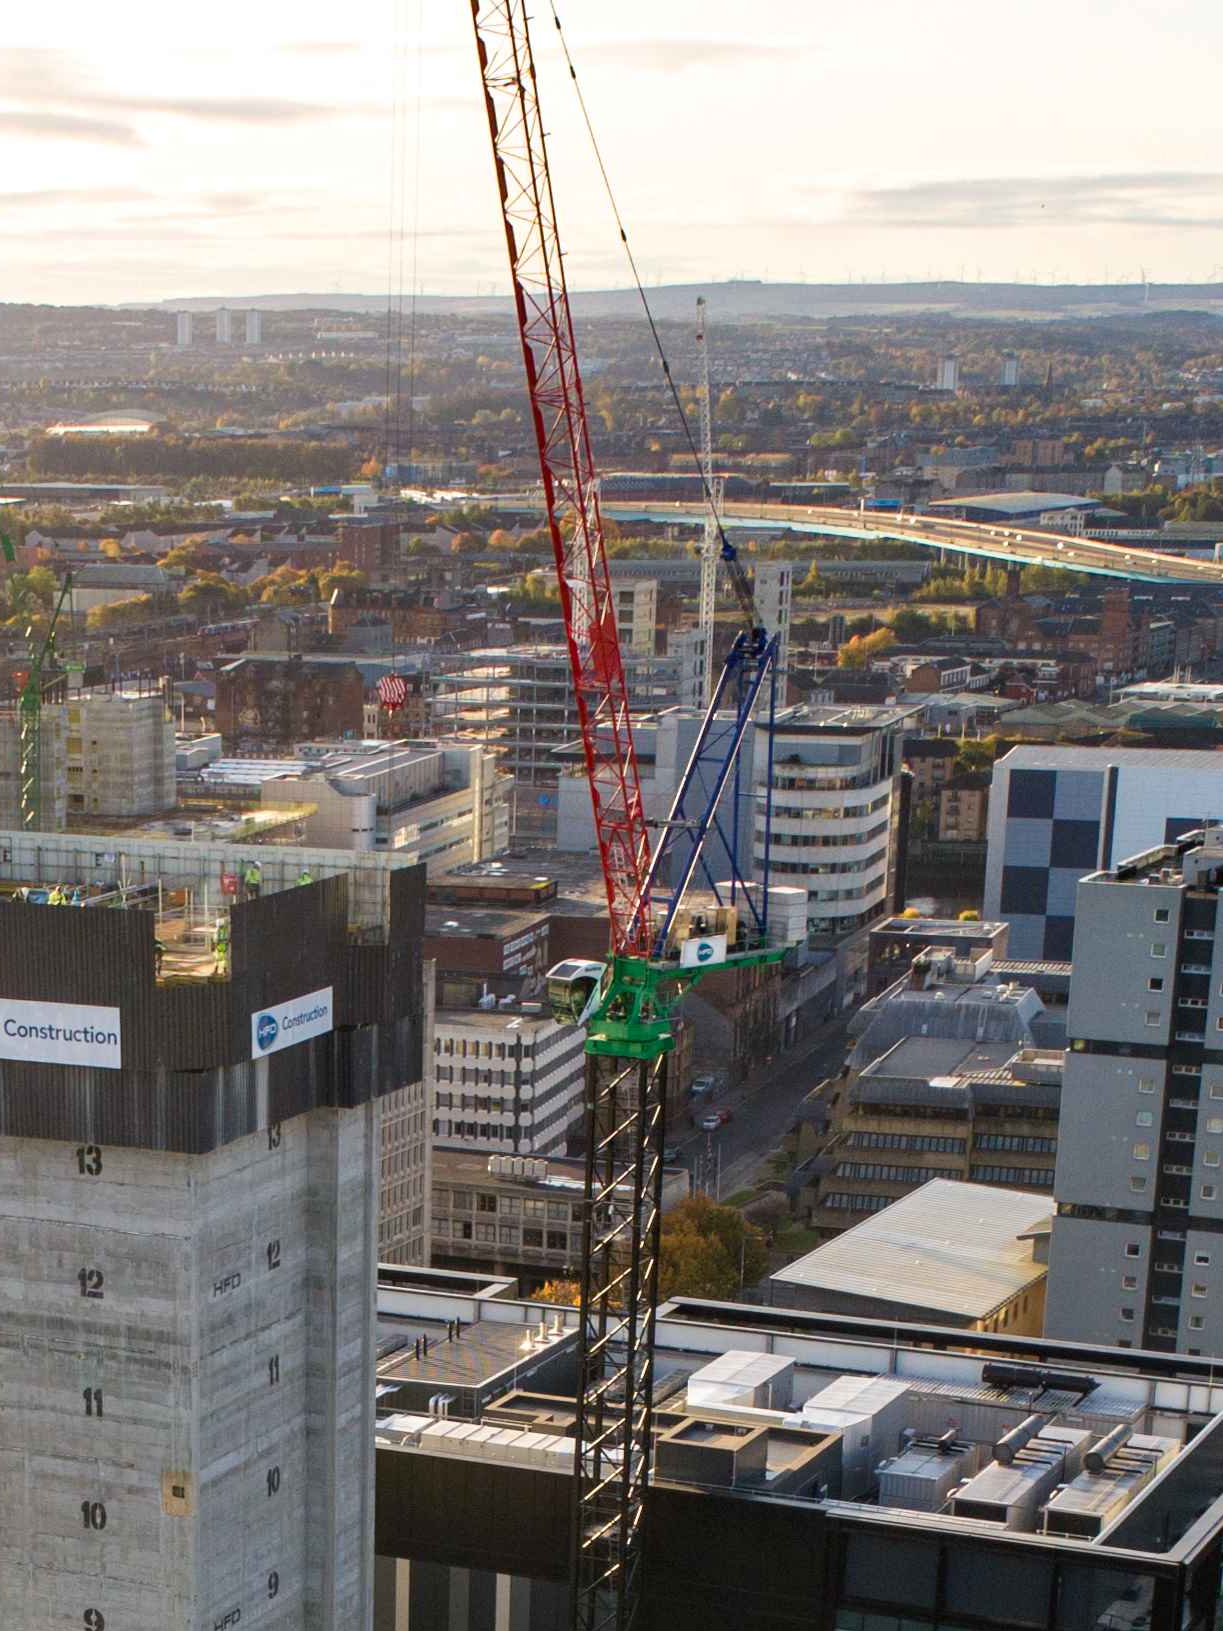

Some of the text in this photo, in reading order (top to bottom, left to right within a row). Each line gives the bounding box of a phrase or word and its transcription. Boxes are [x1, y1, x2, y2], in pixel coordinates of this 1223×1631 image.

[4, 1019, 118, 1045] Construction
[282, 1005, 328, 1030] Construction
[76, 1145, 102, 1176] 13
[267, 1240, 280, 1270] 12
[78, 1267, 104, 1299] 12
[269, 1354, 280, 1385] 11
[83, 1387, 103, 1417] 11
[267, 1466, 280, 1497] 10
[81, 1500, 106, 1530] 10
[268, 1571, 280, 1599] 9
